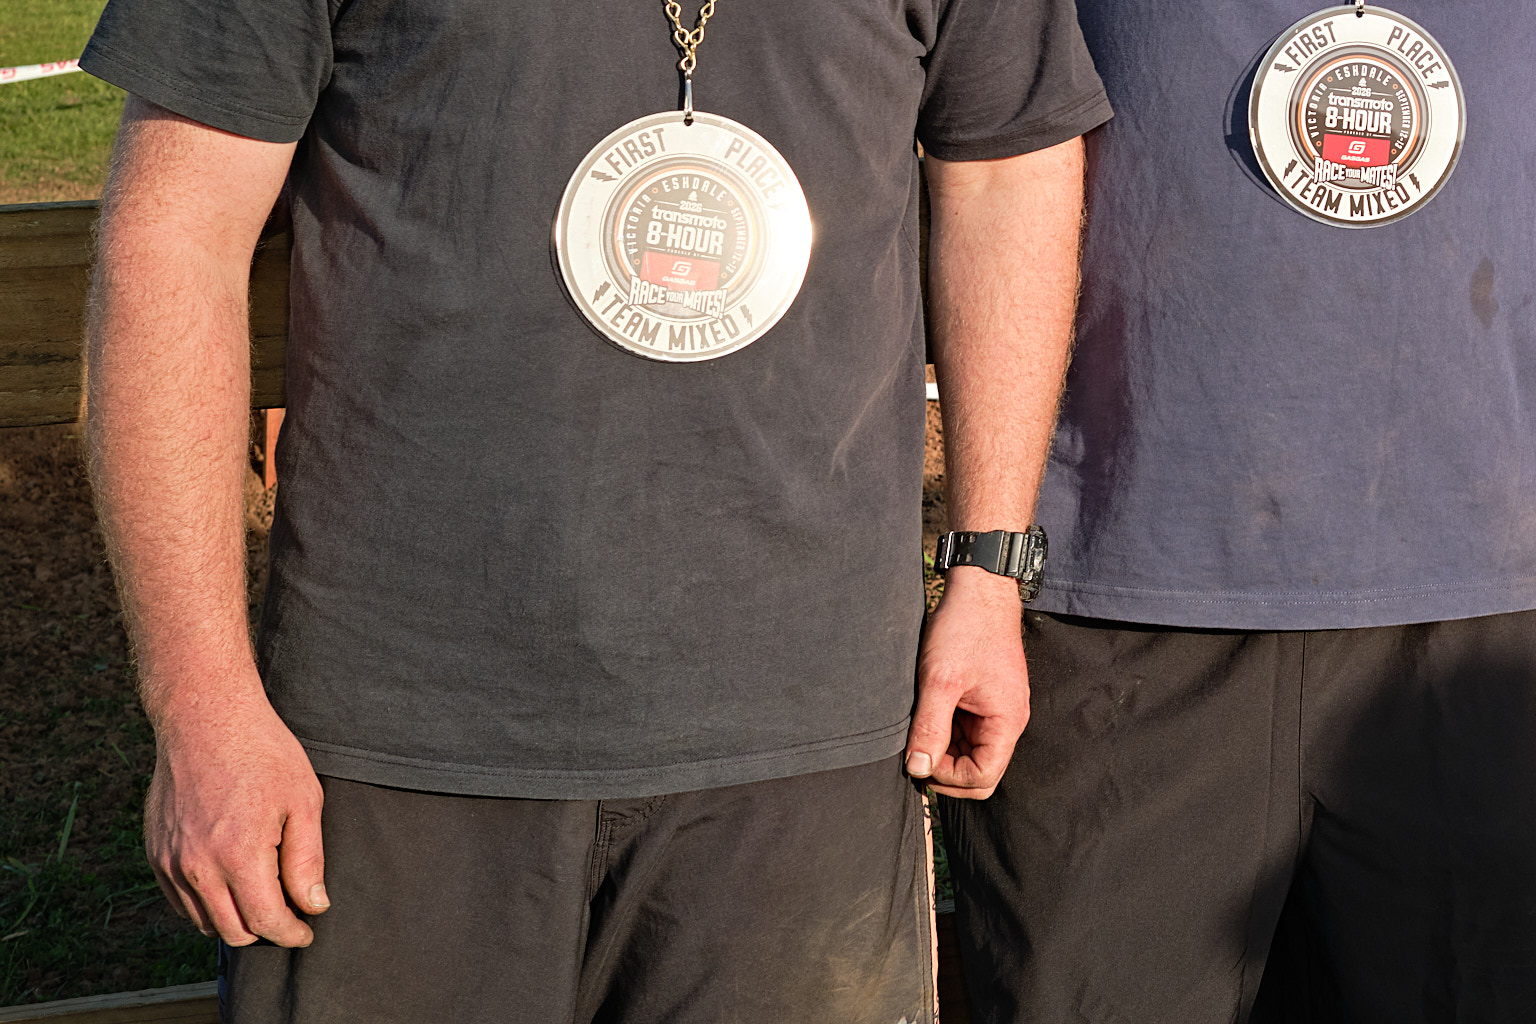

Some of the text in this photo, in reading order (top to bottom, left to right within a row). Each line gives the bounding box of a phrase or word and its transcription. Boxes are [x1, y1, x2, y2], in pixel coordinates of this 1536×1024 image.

[1285, 21, 1442, 79] FIRST PLACE
[1335, 64, 1392, 86] ESKDALE
[1328, 92, 1394, 111] transmoto
[1351, 87, 1371, 96] 2026
[1308, 83, 1327, 138] VICTORIA
[1325, 106, 1392, 134] 8-HOUR
[1395, 90, 1411, 130] SEPTEMBER
[605, 128, 787, 202] FIRST PLACE
[1314, 156, 1346, 183] RACE
[1360, 163, 1398, 191] MATES!
[662, 176, 728, 202] ESKDALE
[1292, 170, 1410, 217] TEAM MIXED
[652, 205, 727, 230] transmoto
[679, 201, 703, 211] 2026
[627, 194, 651, 255] VICTORIA
[646, 222, 724, 255] 8-HOUR
[628, 275, 667, 307] RACE
[662, 276, 696, 286] GASGAS
[601, 293, 740, 351] TEAM MIXED
